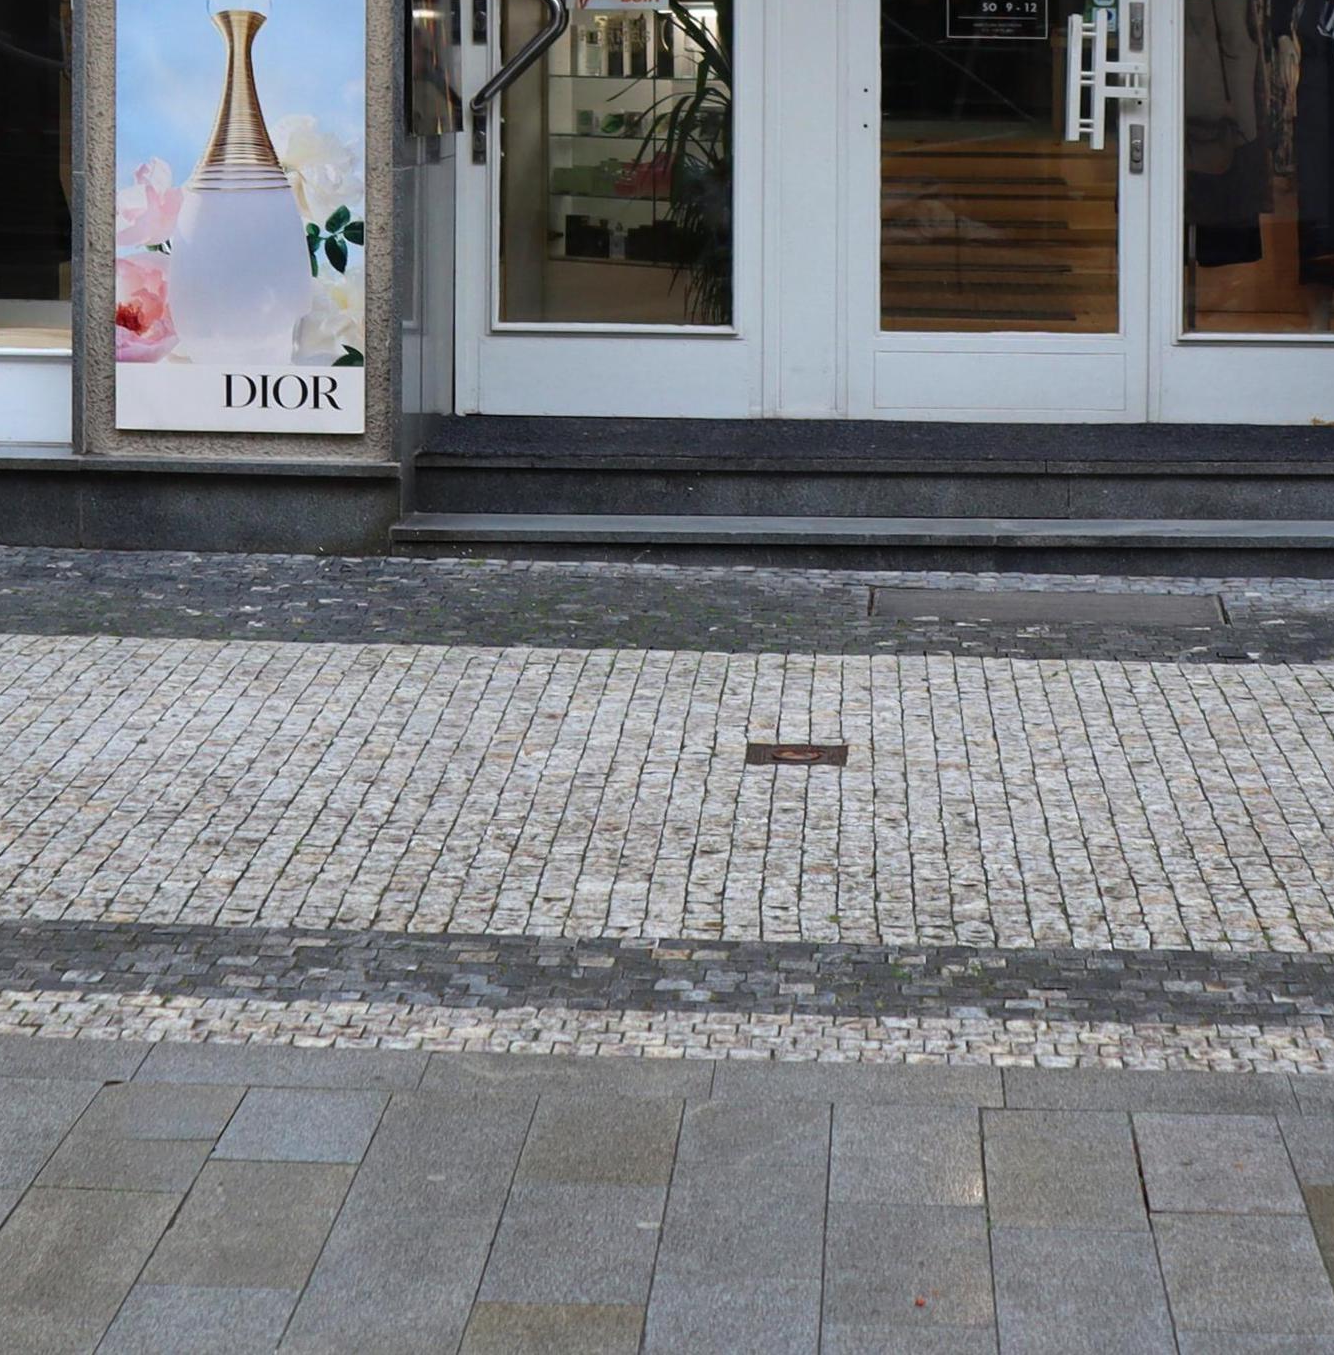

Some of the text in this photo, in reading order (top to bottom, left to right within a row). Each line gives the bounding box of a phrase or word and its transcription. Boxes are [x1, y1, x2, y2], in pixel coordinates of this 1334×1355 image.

[982, 2, 997, 12] SO
[1005, 2, 1013, 12] 9
[1024, 2, 1037, 13] 12
[221, 371, 343, 413] DIOR
